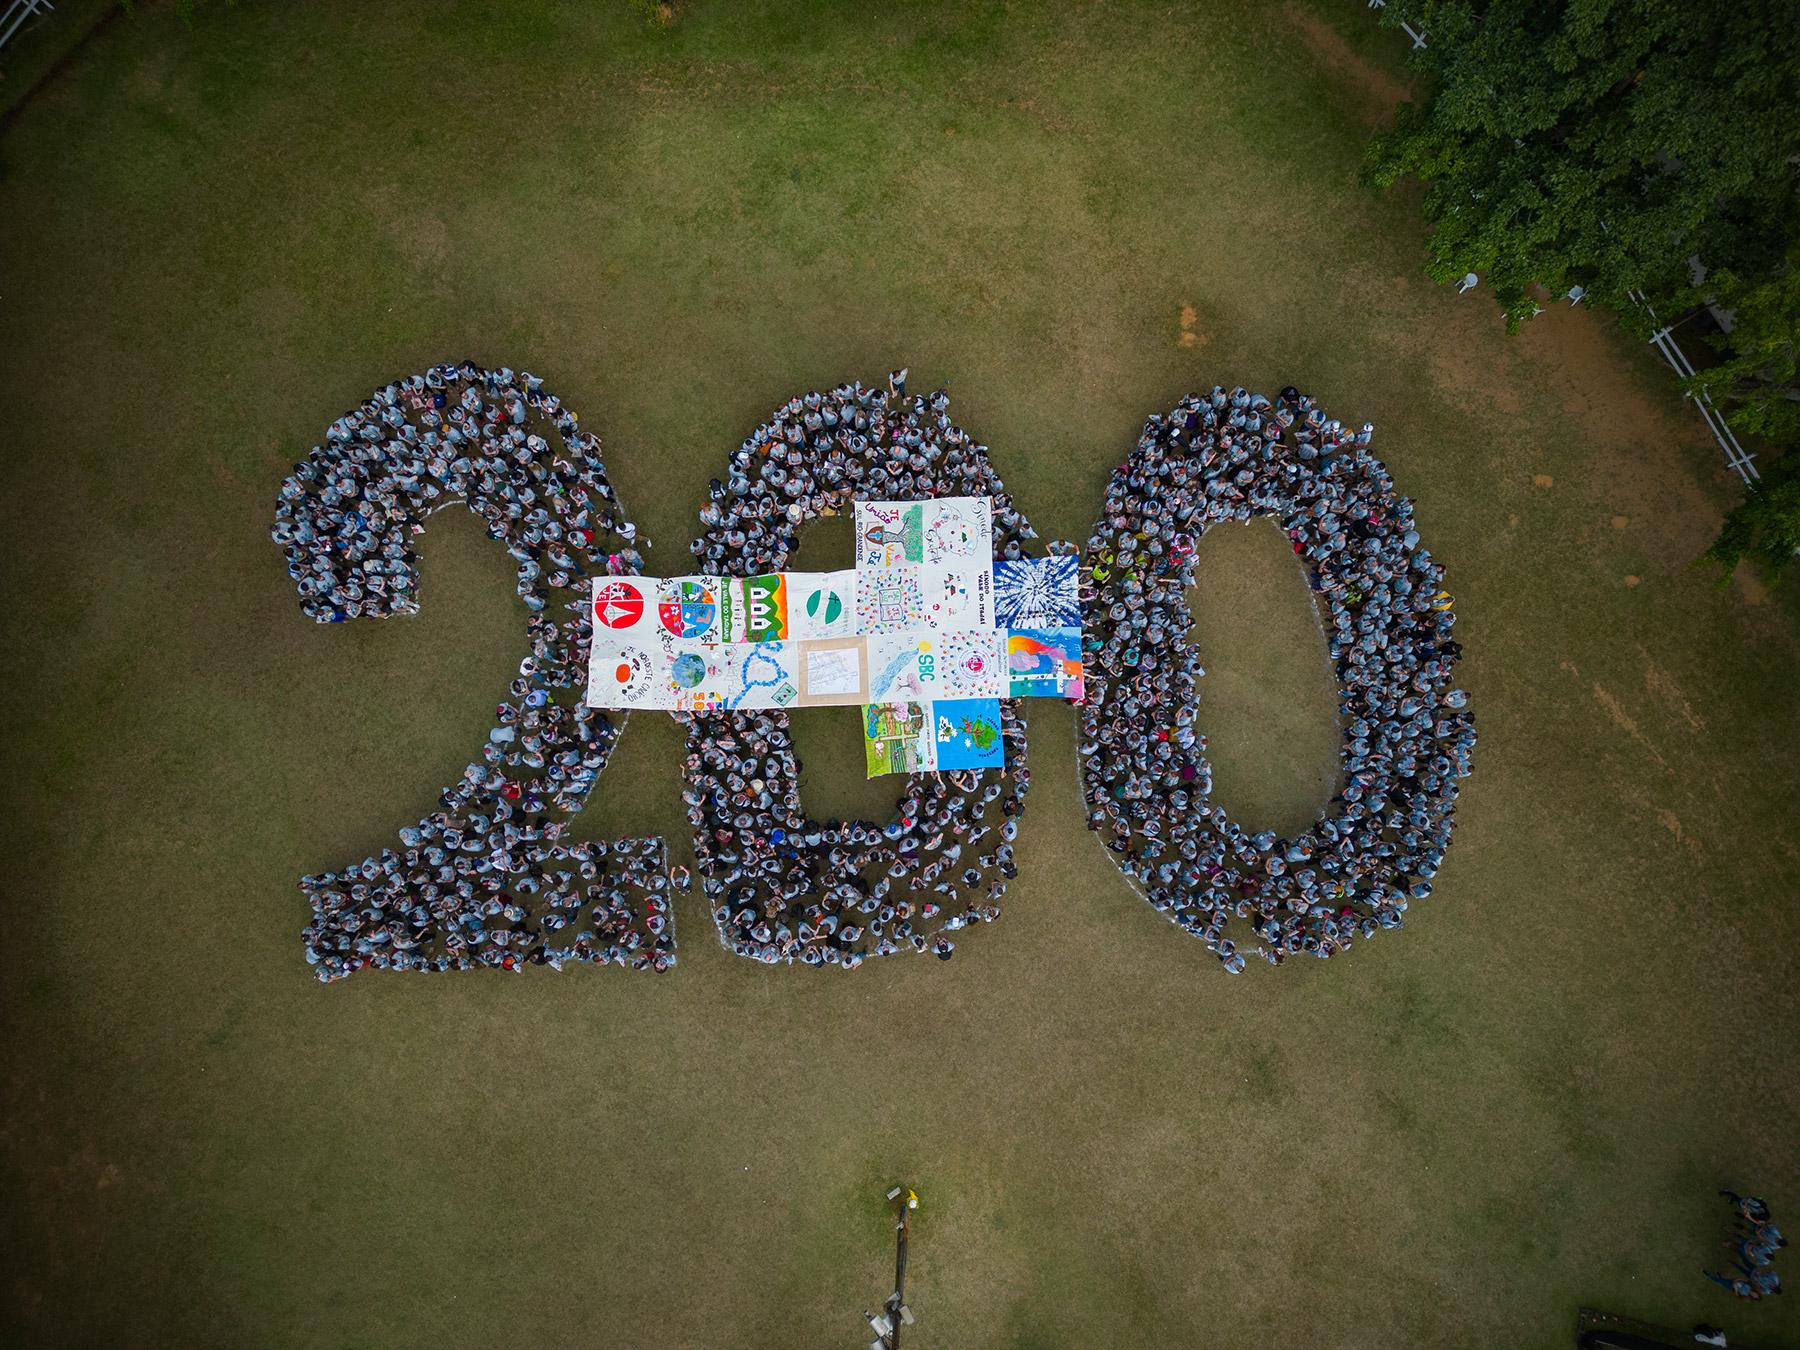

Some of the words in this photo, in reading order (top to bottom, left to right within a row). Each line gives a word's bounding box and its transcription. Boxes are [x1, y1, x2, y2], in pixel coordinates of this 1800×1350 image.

[890, 509, 900, 521] JE
[721, 581, 728, 589] JE
[599, 588, 610, 600] JE
[722, 605, 729, 614] DO
[638, 652, 653, 681] NORDESTE
[918, 654, 936, 682] SBC
